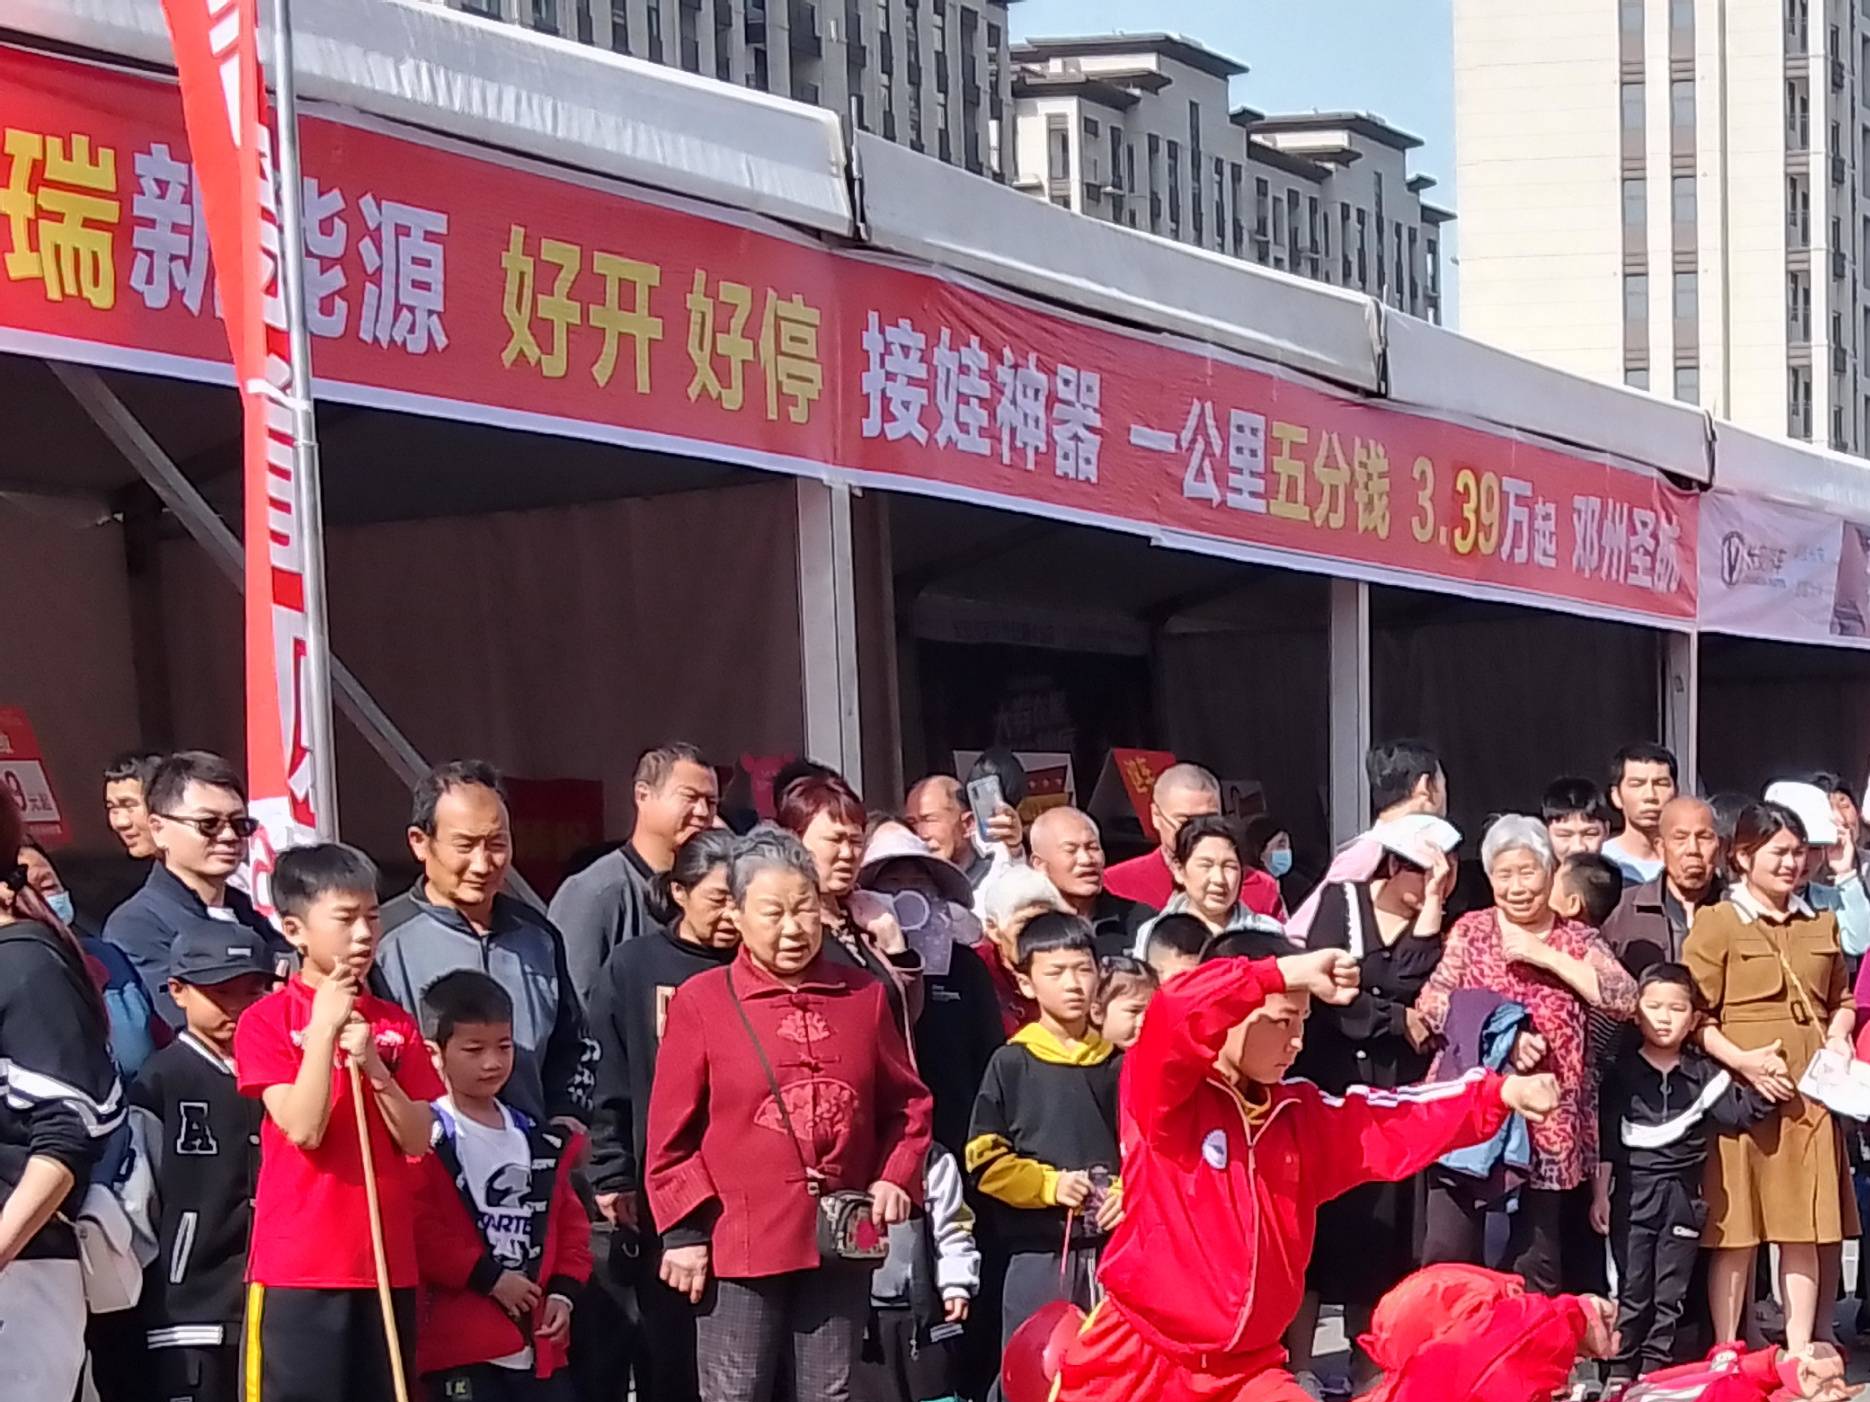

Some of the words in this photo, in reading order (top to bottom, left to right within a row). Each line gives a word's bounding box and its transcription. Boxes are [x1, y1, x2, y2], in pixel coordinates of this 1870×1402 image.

[500, 223, 664, 395] 好开
[686, 268, 824, 425] 好停
[862, 309, 1101, 484] 接娃神器
[1129, 397, 1391, 541] 一公里五分钱
[1411, 456, 1558, 569] 3.39万起
[177, 1102, 218, 1155] A
